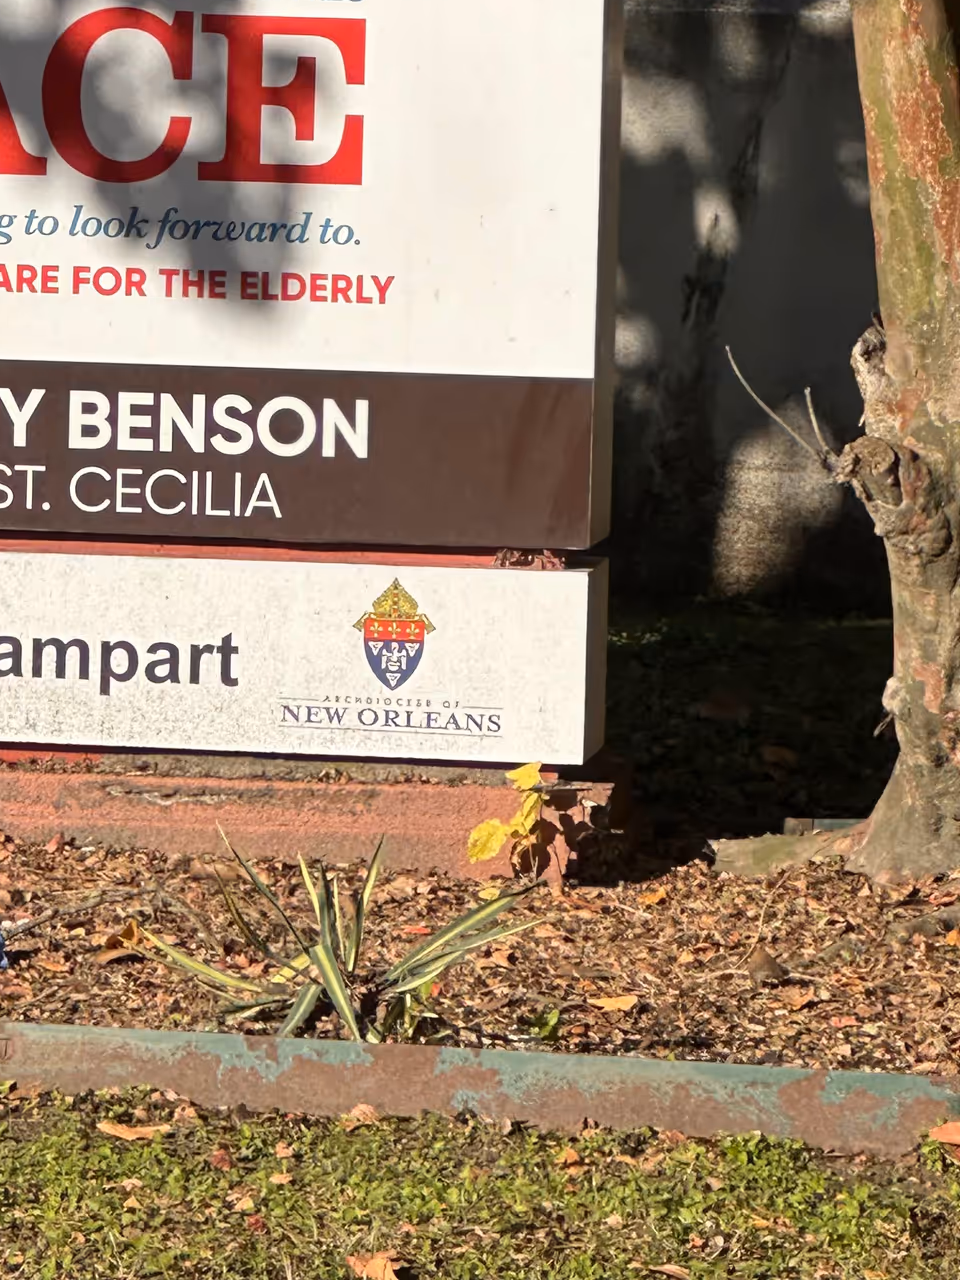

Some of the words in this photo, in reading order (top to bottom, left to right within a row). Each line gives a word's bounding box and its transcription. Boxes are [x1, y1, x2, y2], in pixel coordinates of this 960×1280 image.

[24, 207, 60, 238] to
[68, 205, 149, 240] look
[145, 206, 313, 250] forward
[318, 218, 362, 247] to.
[71, 266, 147, 298] FOR
[158, 268, 227, 300] THE
[240, 271, 396, 306] ELDERLY
[67, 389, 371, 460] BENSON
[68, 466, 283, 519] CECILIA
[280, 704, 348, 726] NEW
[357, 708, 502, 734] ORLEANS
